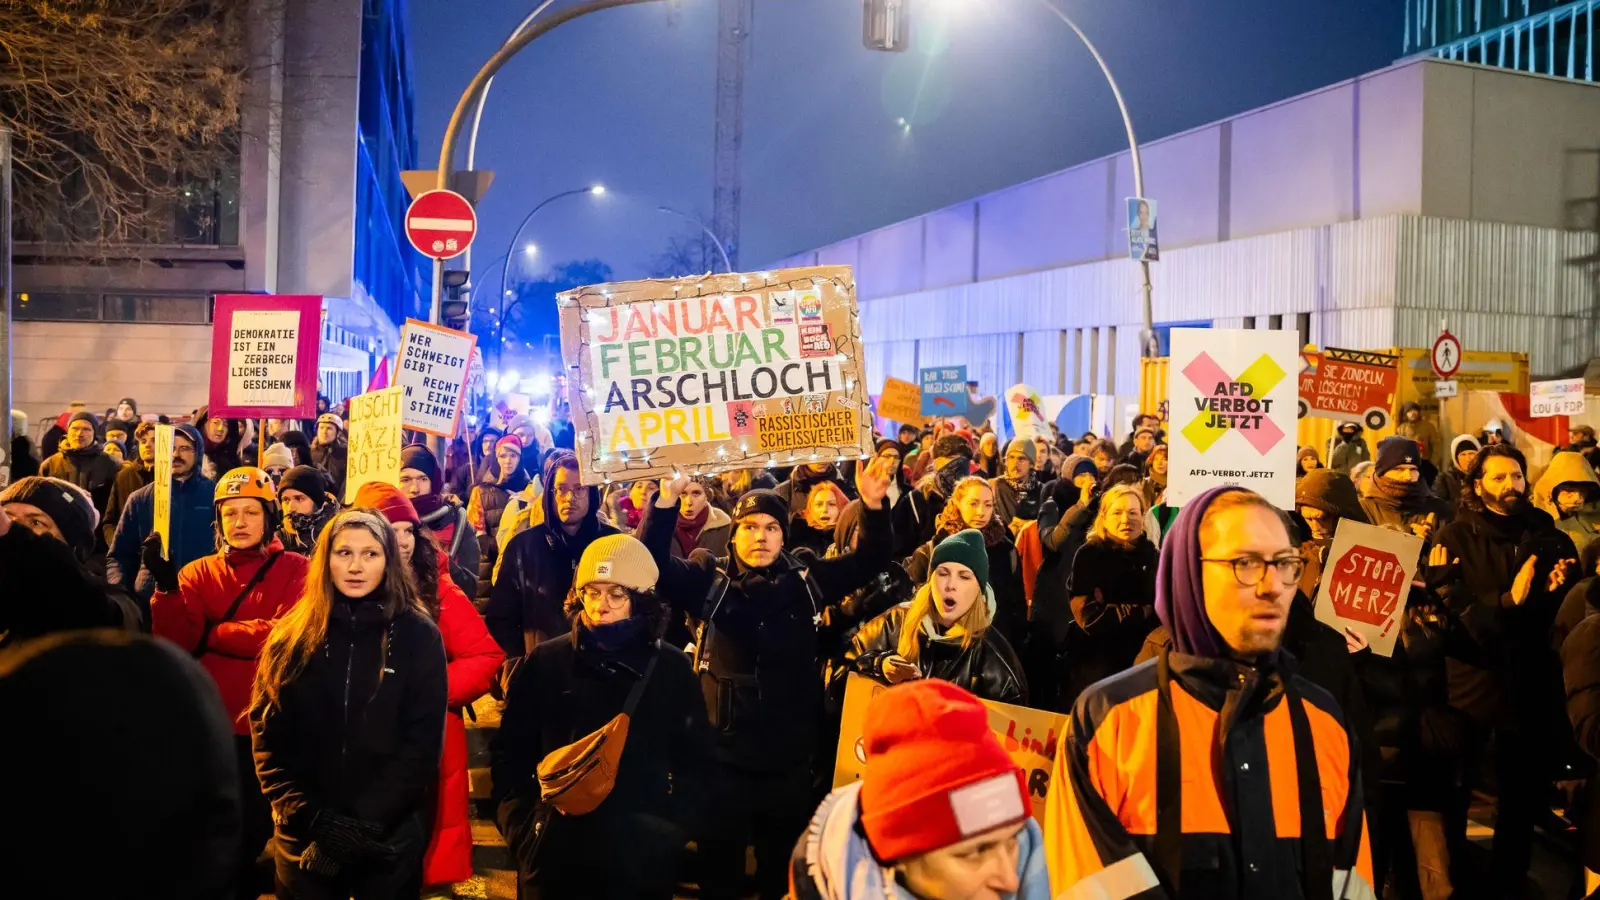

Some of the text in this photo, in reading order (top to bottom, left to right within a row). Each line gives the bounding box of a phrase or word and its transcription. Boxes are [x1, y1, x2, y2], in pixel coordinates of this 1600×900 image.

[598, 295, 762, 343] JANUAR
[234, 329, 295, 339] DEMOKRATIE
[410, 332, 432, 347] WER
[233, 342, 276, 352] IST EIN
[600, 328, 791, 378] FEBRUAR
[244, 354, 294, 364] ZERBRECH
[406, 345, 465, 369] SCHWEIGT
[231, 367, 268, 377] LICHES
[404, 359, 433, 374] GIBT
[1323, 364, 1338, 380] SIE
[243, 380, 292, 390] GESCHENK
[422, 376, 459, 394] RECHT
[603, 360, 832, 414] ARSCHLOCH
[1213, 381, 1254, 397] AFD
[404, 385, 457, 407] N EINE
[410, 400, 453, 419] STIMME
[1194, 397, 1273, 413] VERBOT
[1533, 400, 1584, 414] CDU & FDP
[609, 405, 730, 452] APRIL
[759, 411, 852, 432] RASSISTISCHER
[1205, 414, 1263, 430] JETZT
[348, 424, 397, 454] NAZI
[760, 427, 854, 448] SCHEISSVEREIN
[347, 446, 398, 479] BOTS
[1189, 469, 1275, 479] AFD-VERBOT.JETZT
[1343, 552, 1402, 584] STOPP
